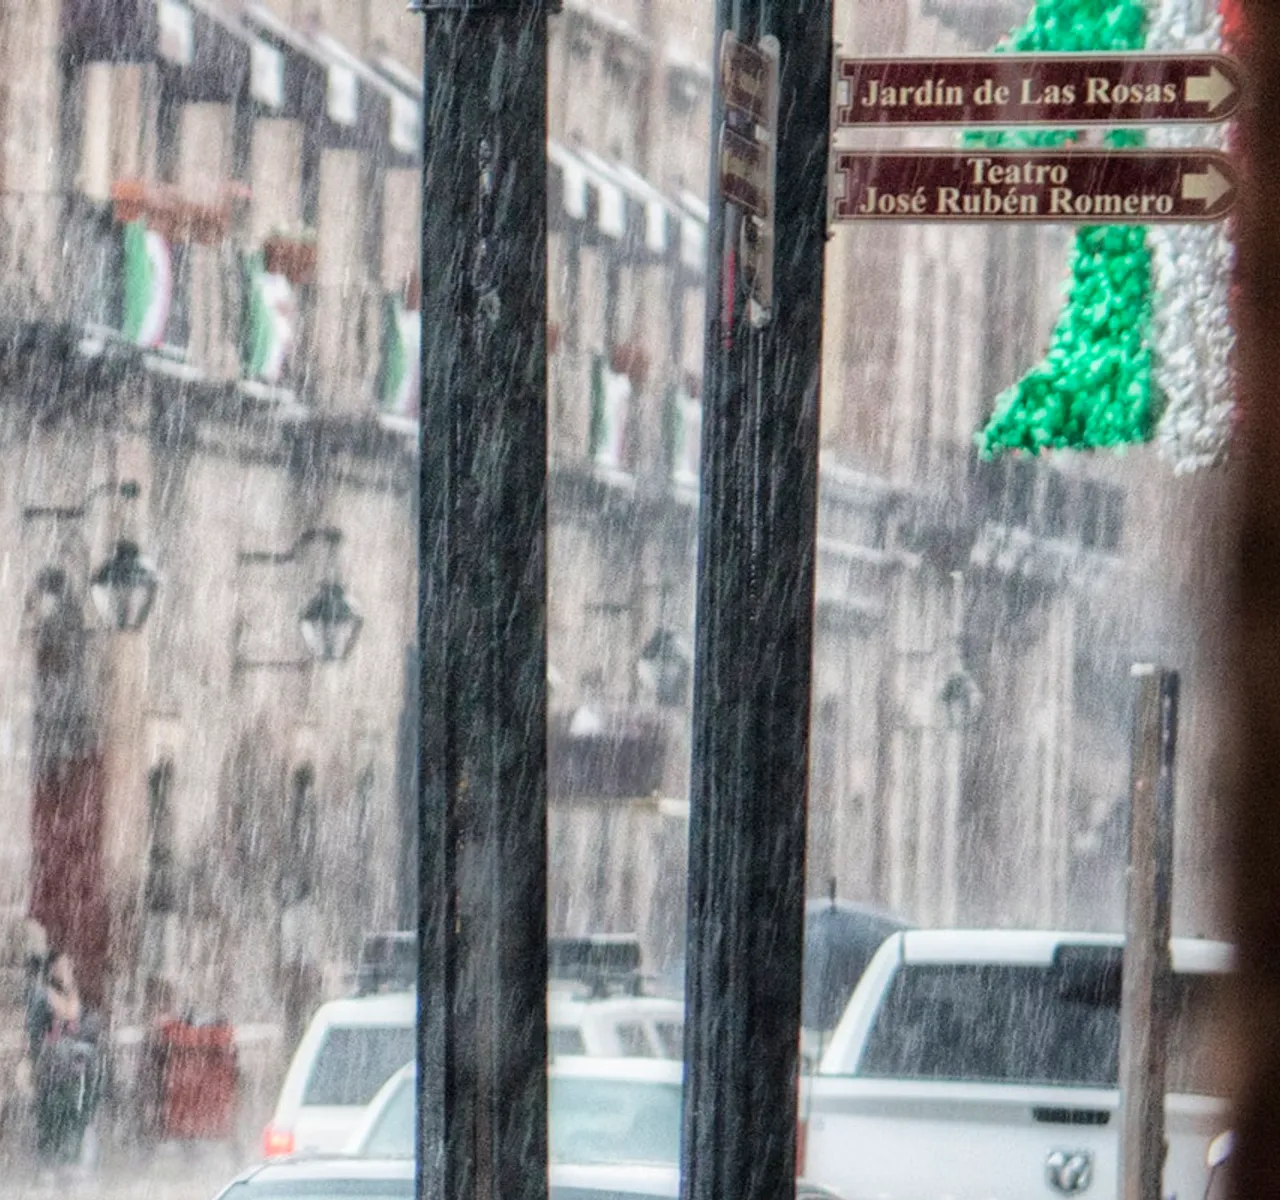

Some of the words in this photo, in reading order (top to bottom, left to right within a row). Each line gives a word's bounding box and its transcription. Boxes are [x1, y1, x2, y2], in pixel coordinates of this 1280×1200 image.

[861, 78, 964, 107] Jardín
[972, 78, 1010, 105] de
[1020, 78, 1076, 105] Las
[1085, 77, 1177, 104] Rosas
[966, 158, 1069, 185] Teatro
[859, 186, 927, 214] José
[936, 186, 1039, 214] Rubén
[1048, 186, 1174, 214] Romero
